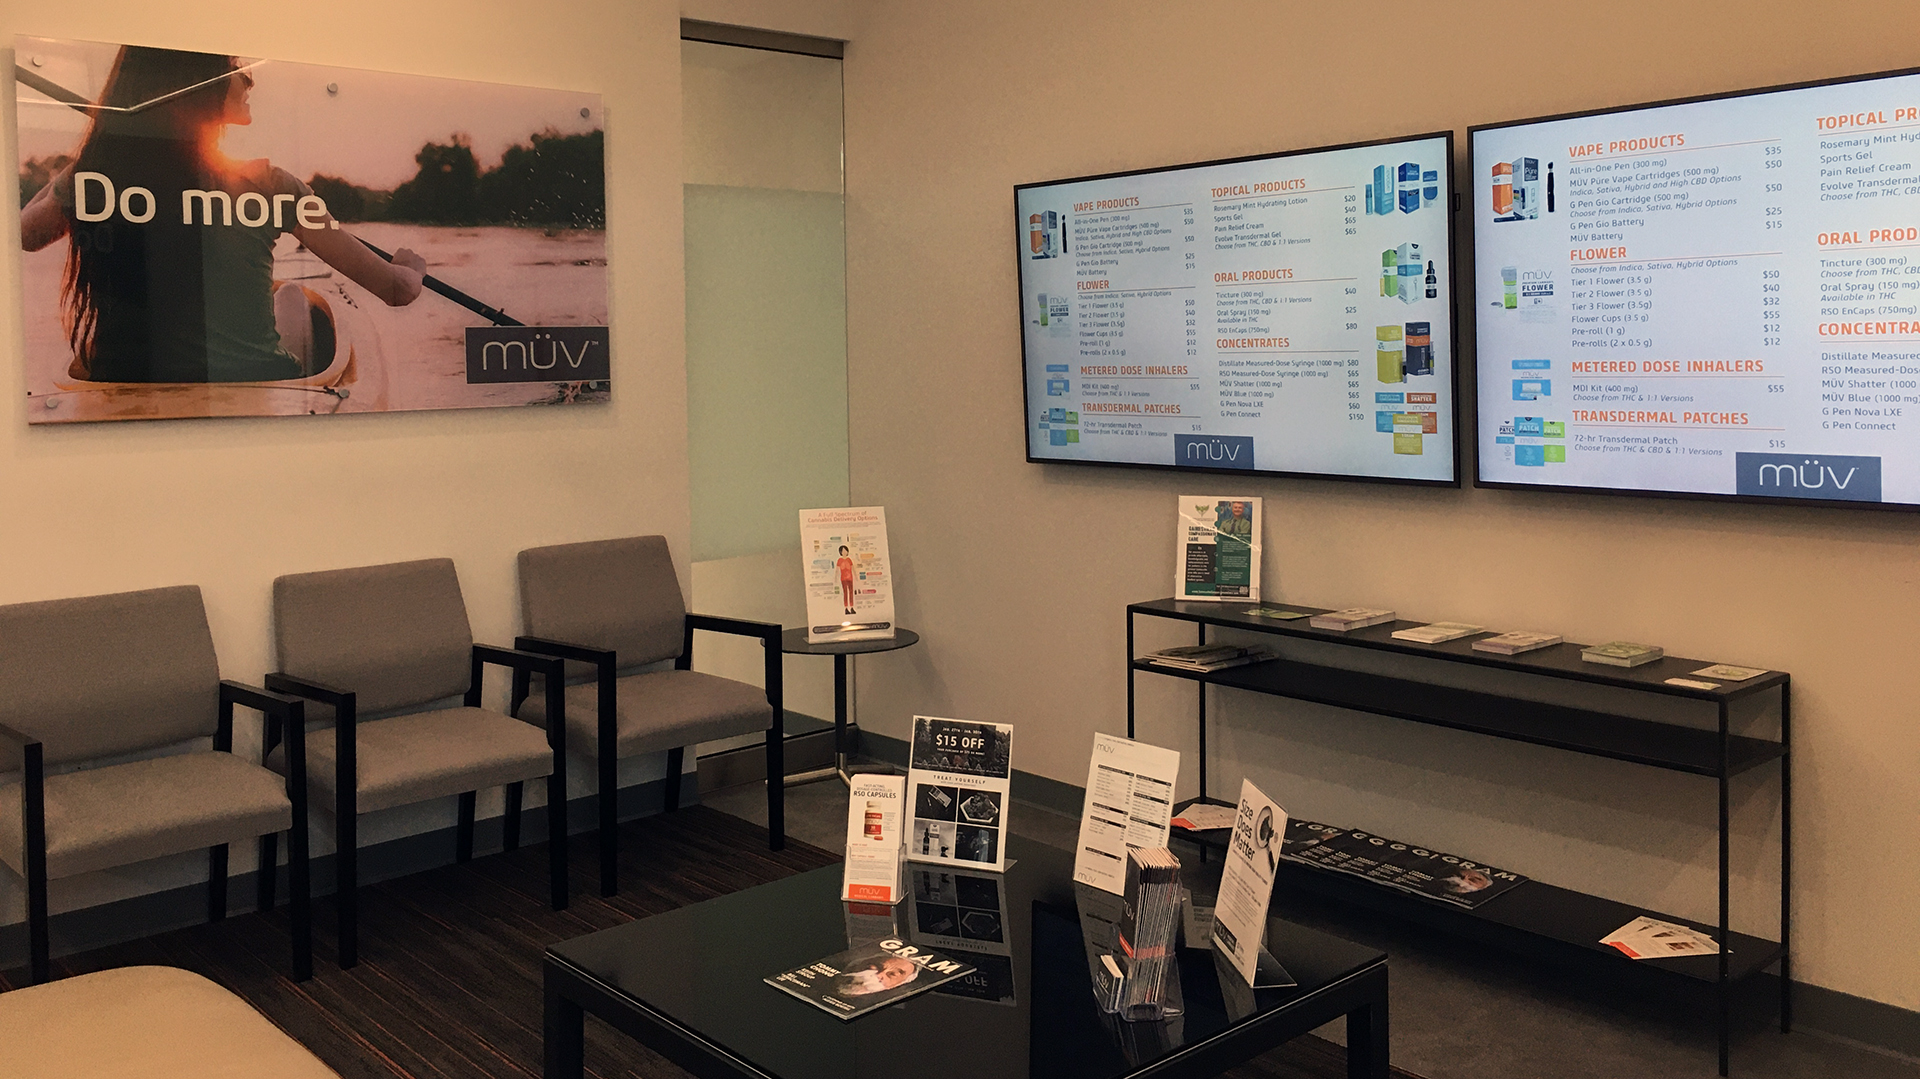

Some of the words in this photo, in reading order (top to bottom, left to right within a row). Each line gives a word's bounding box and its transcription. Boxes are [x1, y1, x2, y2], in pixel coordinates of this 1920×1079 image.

[1816, 111, 1888, 130] TOPICAL
[1569, 143, 1603, 157] VAPE
[1610, 134, 1684, 153] PRODUCTS
[1570, 165, 1612, 175] All-in-One
[1633, 160, 1650, 170] (300
[1652, 158, 1667, 167] mg)
[1765, 146, 1782, 156] $35
[1820, 154, 1852, 164] Sports
[1856, 151, 1872, 160] Gel
[1570, 178, 1588, 188] MÜV
[1636, 171, 1680, 181] Cartridges
[1683, 168, 1701, 177] (500
[1704, 166, 1719, 175] mg)
[1765, 160, 1782, 169] $50
[1820, 169, 1842, 177] Pain
[1846, 164, 1875, 175] Relief
[1879, 163, 1911, 172] Cream
[1211, 185, 1250, 198] TOPICAL
[1254, 178, 1305, 193] PRODUCTS
[74, 172, 156, 224] Do
[182, 188, 340, 230] more.
[1074, 202, 1094, 212] VAPE
[1097, 196, 1140, 210] PRODUCTS
[1257, 200, 1287, 209] Hydrating
[1612, 219, 1644, 227] Battery
[1766, 207, 1782, 216] $25
[1766, 220, 1782, 230] $15
[1818, 232, 1862, 245] ORAL
[1571, 247, 1626, 261] FLOWER
[1214, 272, 1239, 283] ORAL
[1242, 269, 1293, 281] PRODUCTS
[1522, 269, 1552, 280] müv
[1627, 276, 1642, 284] (3.5
[1644, 276, 1652, 284] g)
[1763, 270, 1780, 279] $50
[1077, 280, 1109, 290] FLOWER
[1522, 282, 1553, 292] FLOWER
[1602, 315, 1621, 323] Cups
[1641, 314, 1649, 322] g)
[1764, 310, 1780, 319] $55
[1842, 307, 1875, 316] EnCaps
[1878, 305, 1917, 315] (750mg)
[1217, 338, 1289, 348] CONCENTRATES
[1081, 366, 1118, 375] METERED
[1121, 366, 1142, 375] DOSE
[1145, 366, 1188, 375] INHALERS
[1572, 361, 1637, 372] METERED
[1643, 361, 1680, 372] DOSE
[1688, 360, 1763, 372] INHALERS
[1624, 385, 1638, 394] mg)
[1768, 385, 1784, 393] $55
[1082, 402, 1142, 413] TRANSDERMAL
[1145, 404, 1181, 414] PATCHES
[1572, 410, 1677, 423] TRANSDERMAL
[1684, 412, 1748, 425] PATCHES
[1822, 421, 1829, 429] G
[1833, 421, 1851, 429] Pen
[1855, 422, 1896, 430] Connect
[1599, 435, 1650, 444] Transdermal
[1653, 436, 1678, 444] Patch
[1769, 439, 1786, 448] $15
[1760, 460, 1856, 490] müv
[936, 734, 957, 747] $15
[962, 737, 985, 750] OFF
[955, 776, 986, 785] YOURSELF
[1240, 798, 1253, 821] Size
[1237, 814, 1253, 838] Does
[1232, 832, 1255, 861] Matter
[1442, 856, 1518, 881] GRAM
[879, 939, 963, 975] GRAM
